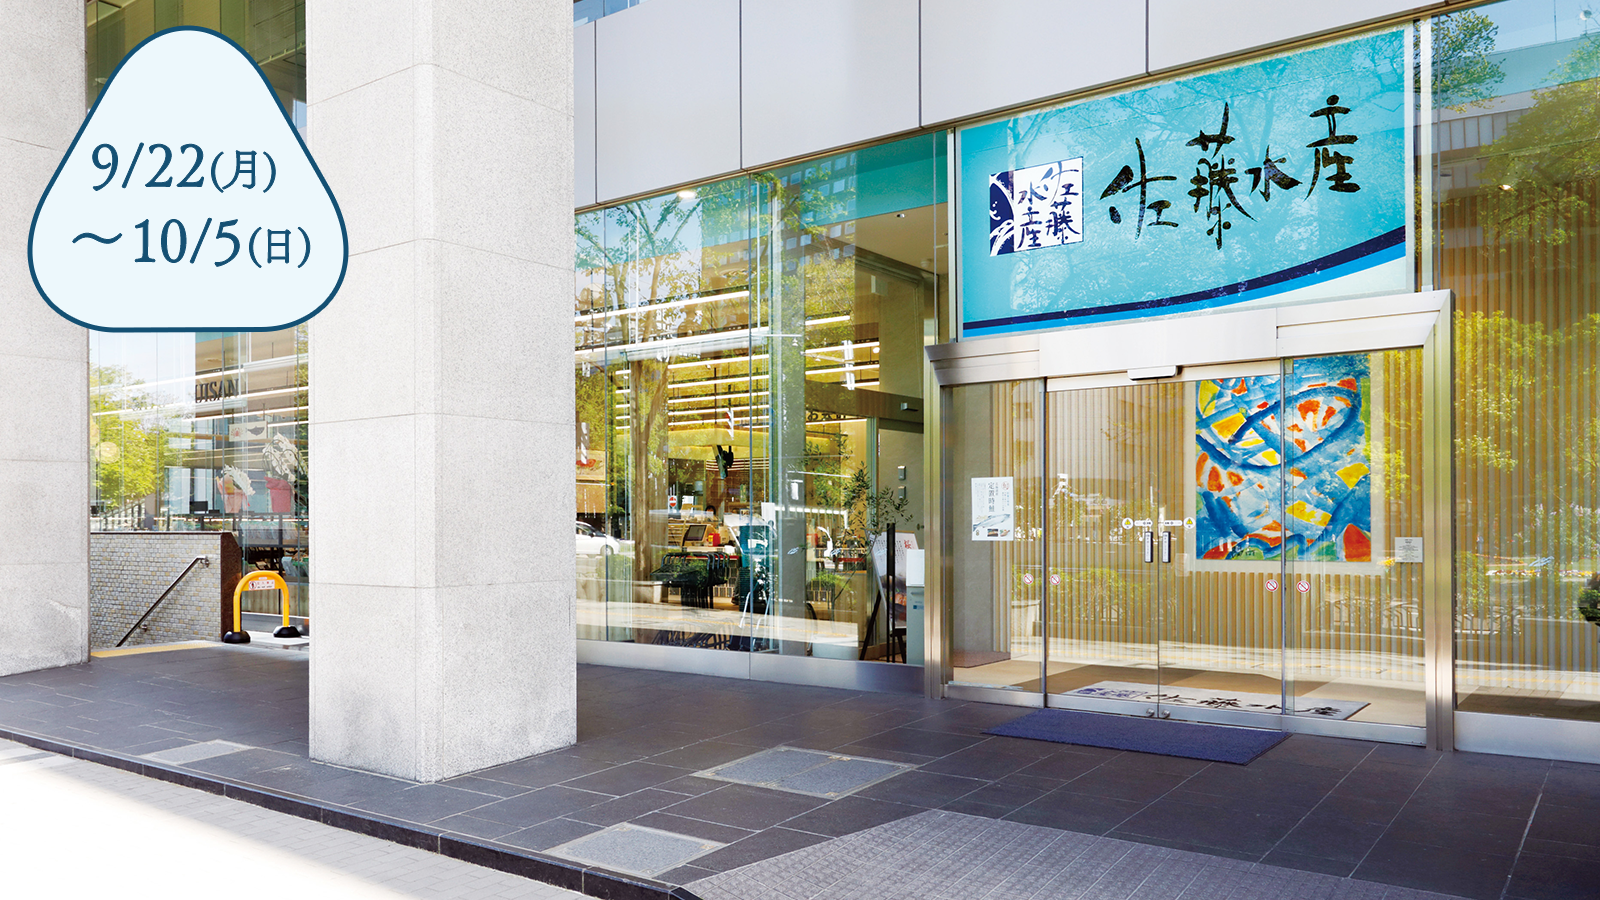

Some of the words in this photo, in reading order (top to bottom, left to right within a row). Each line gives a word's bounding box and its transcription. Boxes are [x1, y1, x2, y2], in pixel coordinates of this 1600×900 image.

[1041, 161, 1081, 245] 佐藤
[1099, 94, 1361, 251] 佐藤水産
[1017, 181, 1048, 249] 水産
